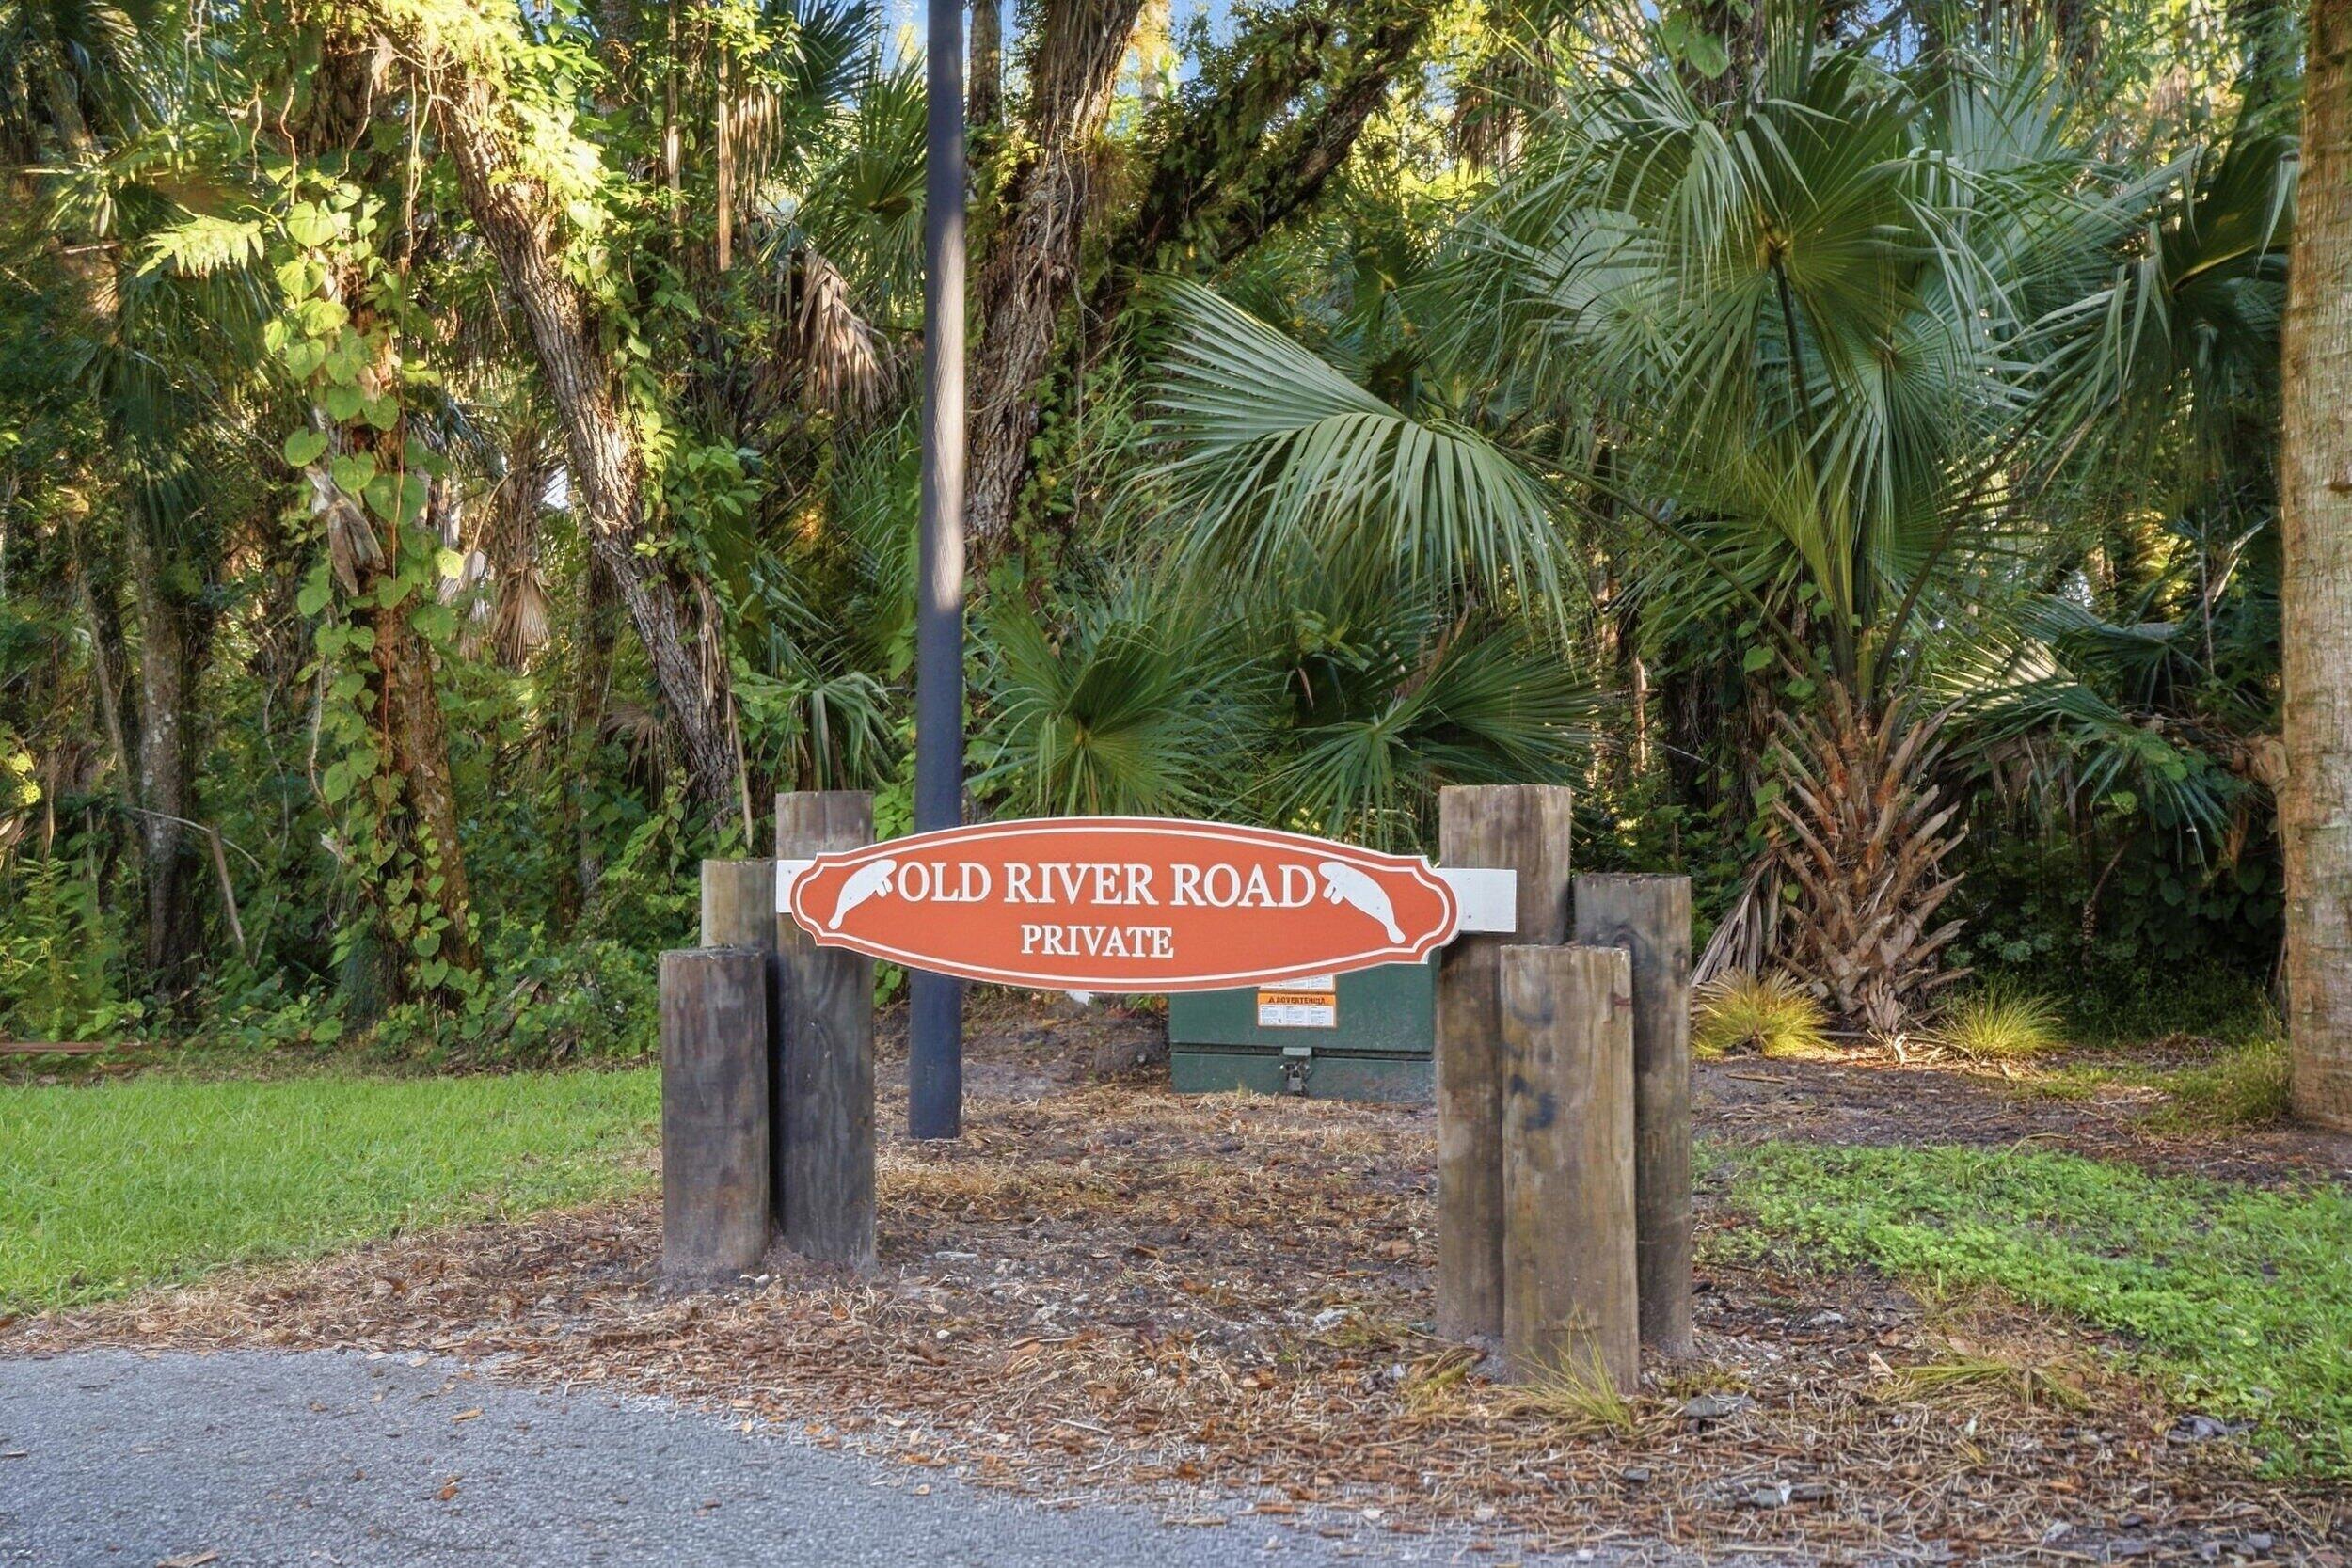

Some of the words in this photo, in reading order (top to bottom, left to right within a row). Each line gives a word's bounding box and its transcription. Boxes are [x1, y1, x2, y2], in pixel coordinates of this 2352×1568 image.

[897, 861, 992, 903] OLD
[1003, 863, 1159, 906] RIVER
[1169, 863, 1317, 908] ROAD
[1020, 924, 1174, 958] PRIVATE
